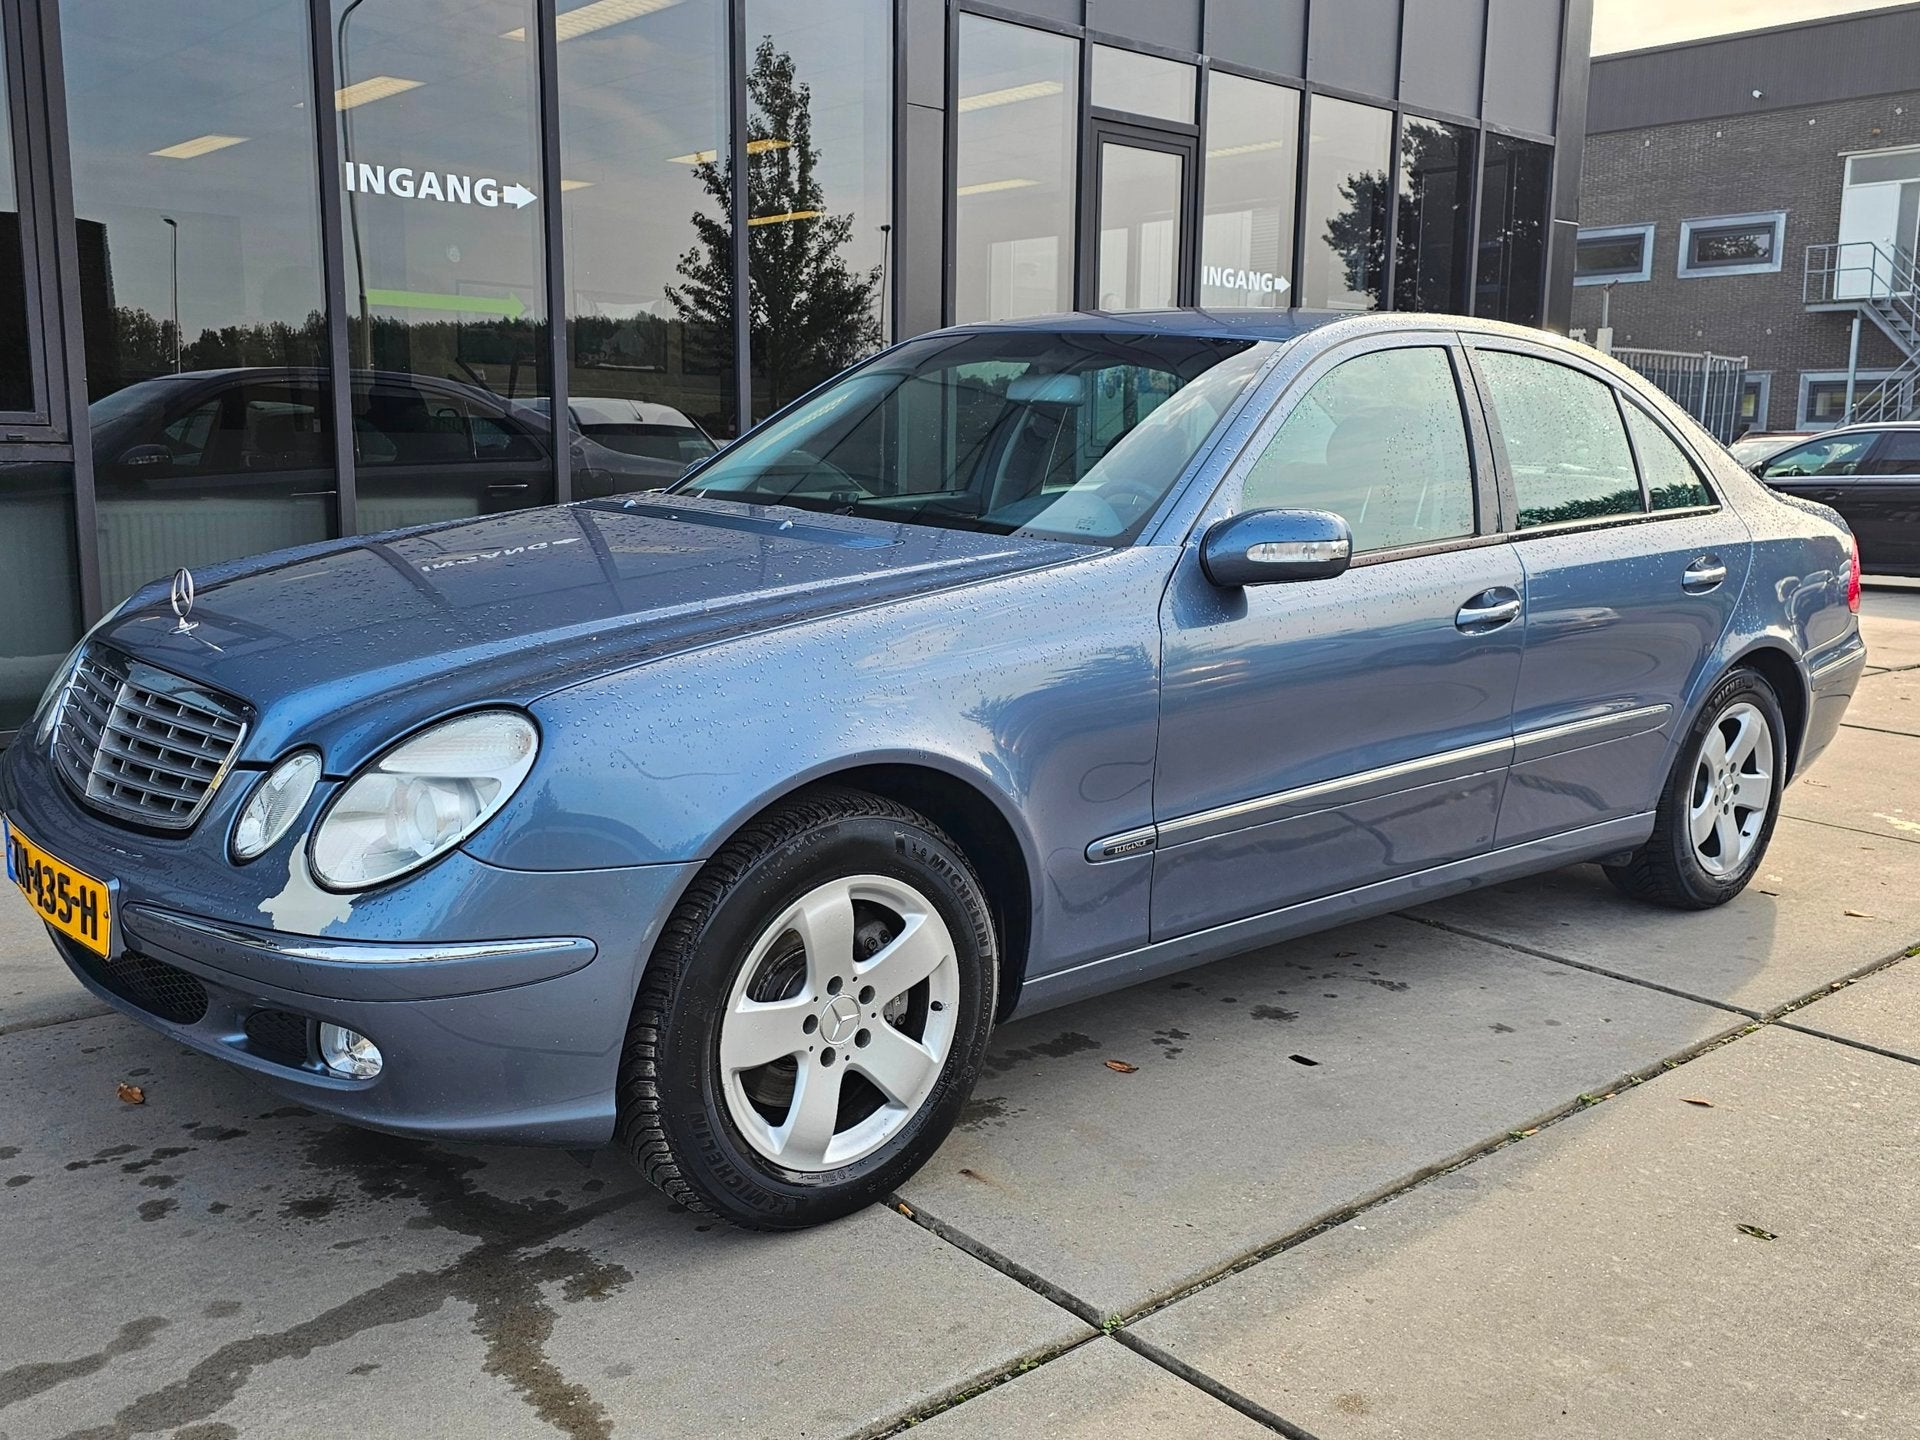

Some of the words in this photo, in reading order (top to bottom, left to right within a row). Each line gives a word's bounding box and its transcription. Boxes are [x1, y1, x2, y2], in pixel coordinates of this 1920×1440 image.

[345, 161, 499, 207] INGANG
[1203, 265, 1273, 293] INGANG
[929, 853, 989, 948] MICHELIN
